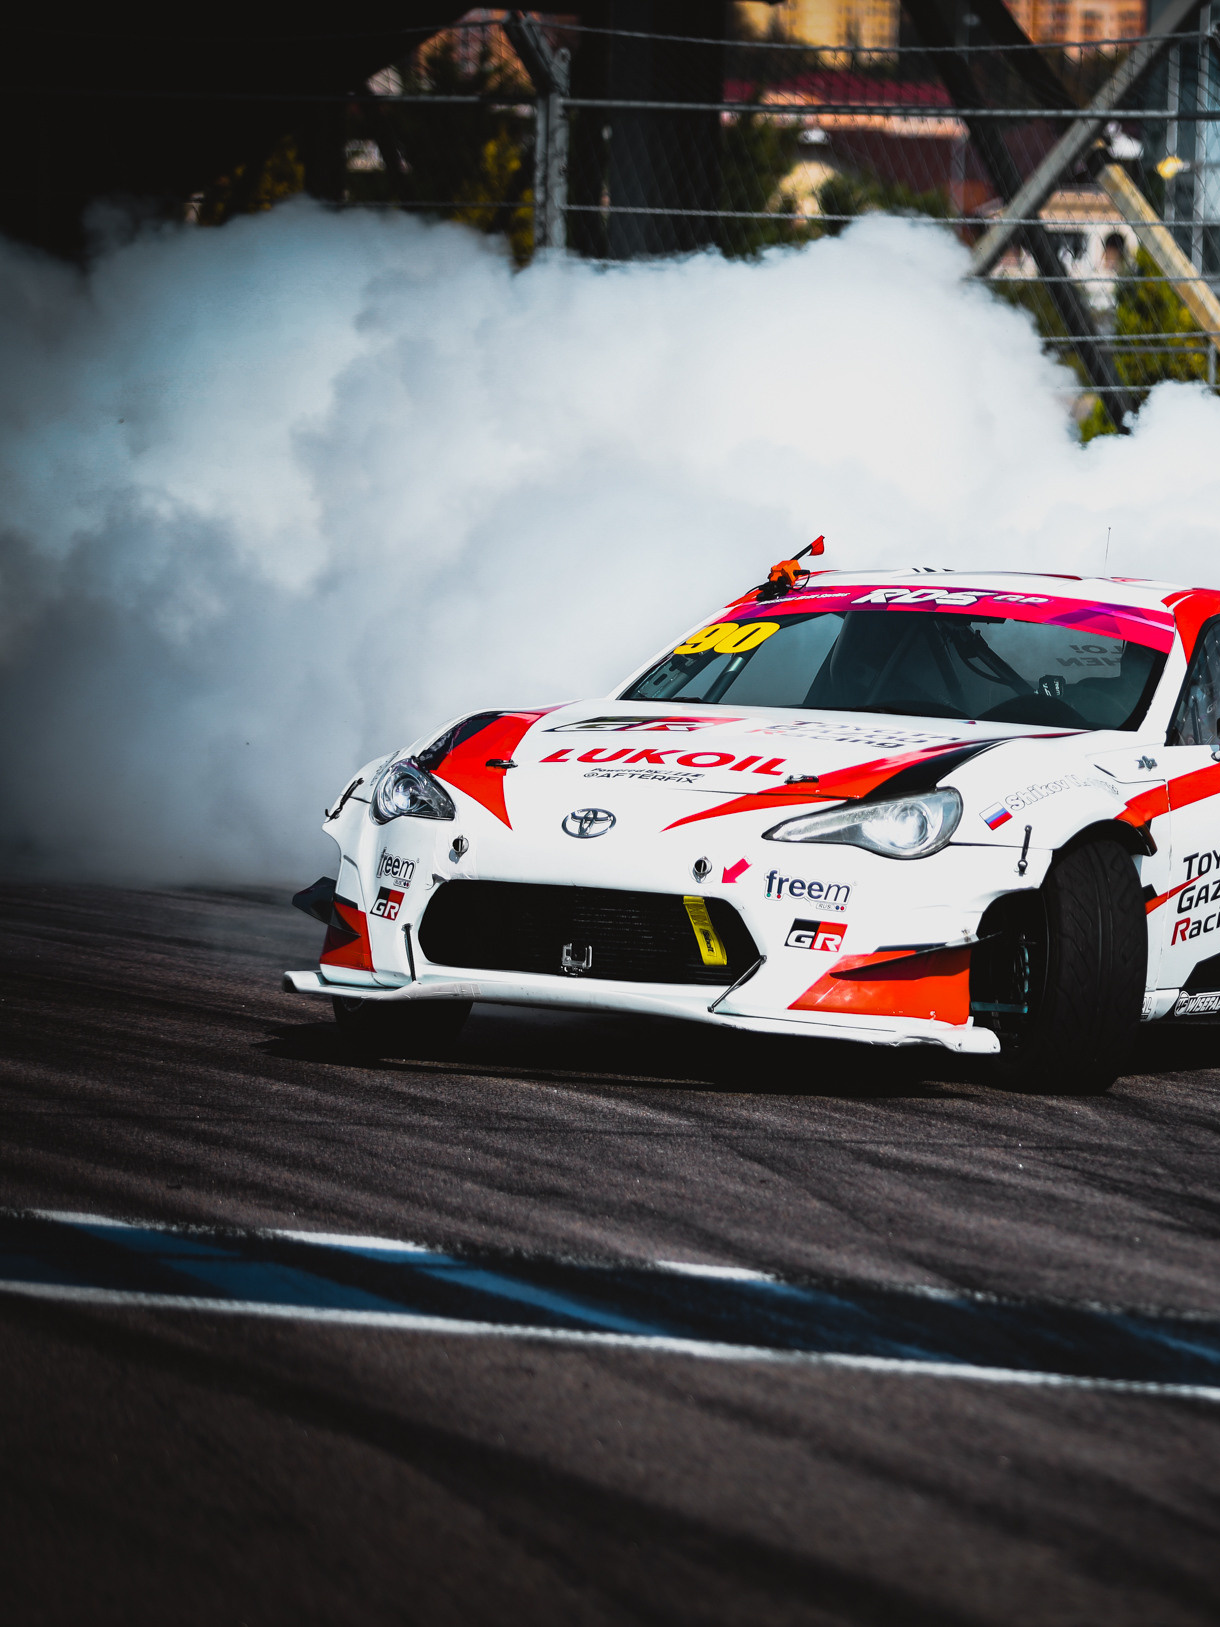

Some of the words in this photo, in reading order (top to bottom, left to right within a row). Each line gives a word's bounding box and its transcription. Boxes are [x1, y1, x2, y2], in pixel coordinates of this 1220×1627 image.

[851, 588, 998, 607] RDS
[673, 622, 780, 655] 90
[747, 728, 904, 748] Racing
[538, 748, 787, 776] LUKOIL
[584, 772, 698, 784] @AFTERFIX
[1005, 778, 1071, 811] Shikov
[376, 847, 415, 879] freem
[766, 870, 851, 903] freem
[372, 899, 400, 919] GR
[787, 930, 842, 952] GR
